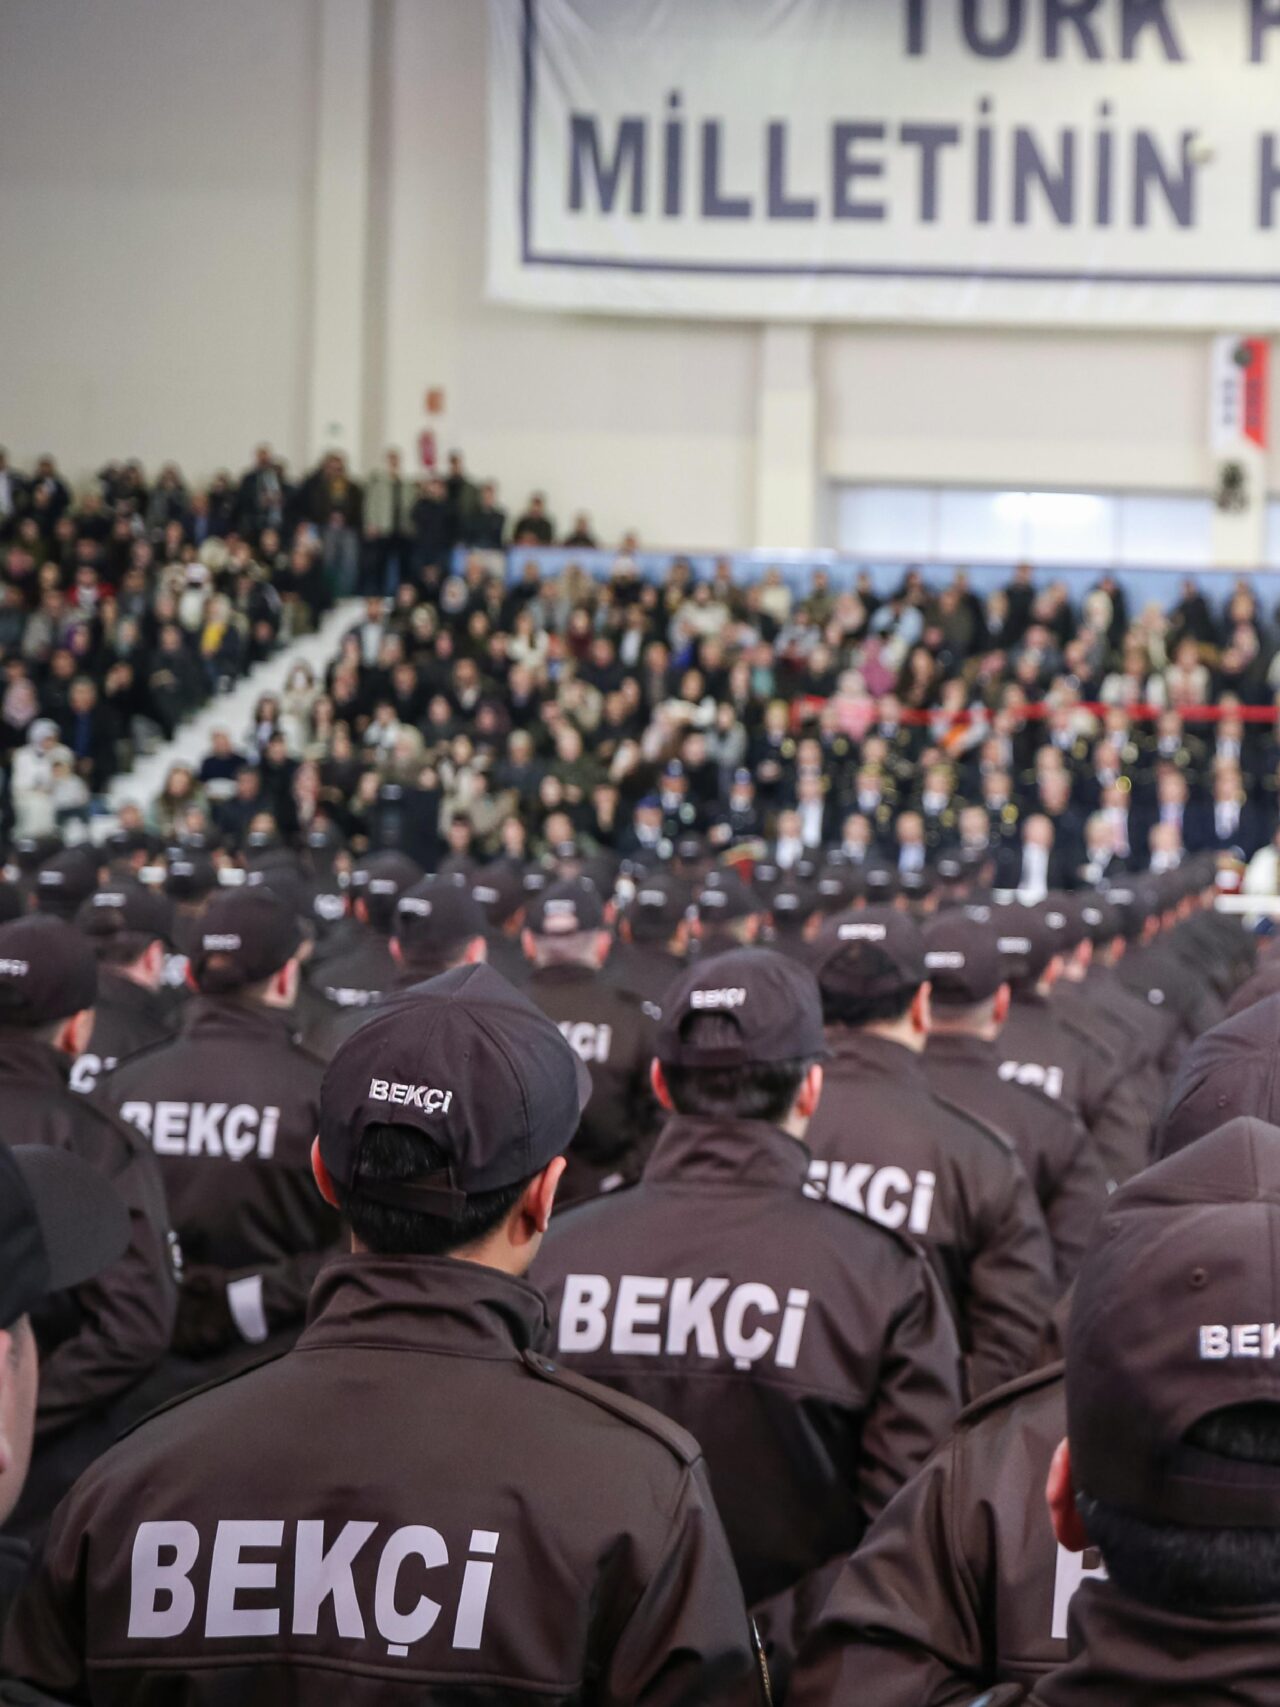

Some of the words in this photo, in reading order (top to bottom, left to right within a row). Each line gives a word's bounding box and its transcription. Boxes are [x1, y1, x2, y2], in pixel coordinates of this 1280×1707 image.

[568, 90, 1196, 229] MİLLETİNİN
[368, 1078, 453, 1114] BEKÇİ
[802, 1160, 936, 1234] KÇİ
[558, 1273, 810, 1369] BEKÇİ
[127, 1519, 500, 1657] BEKÇİ
